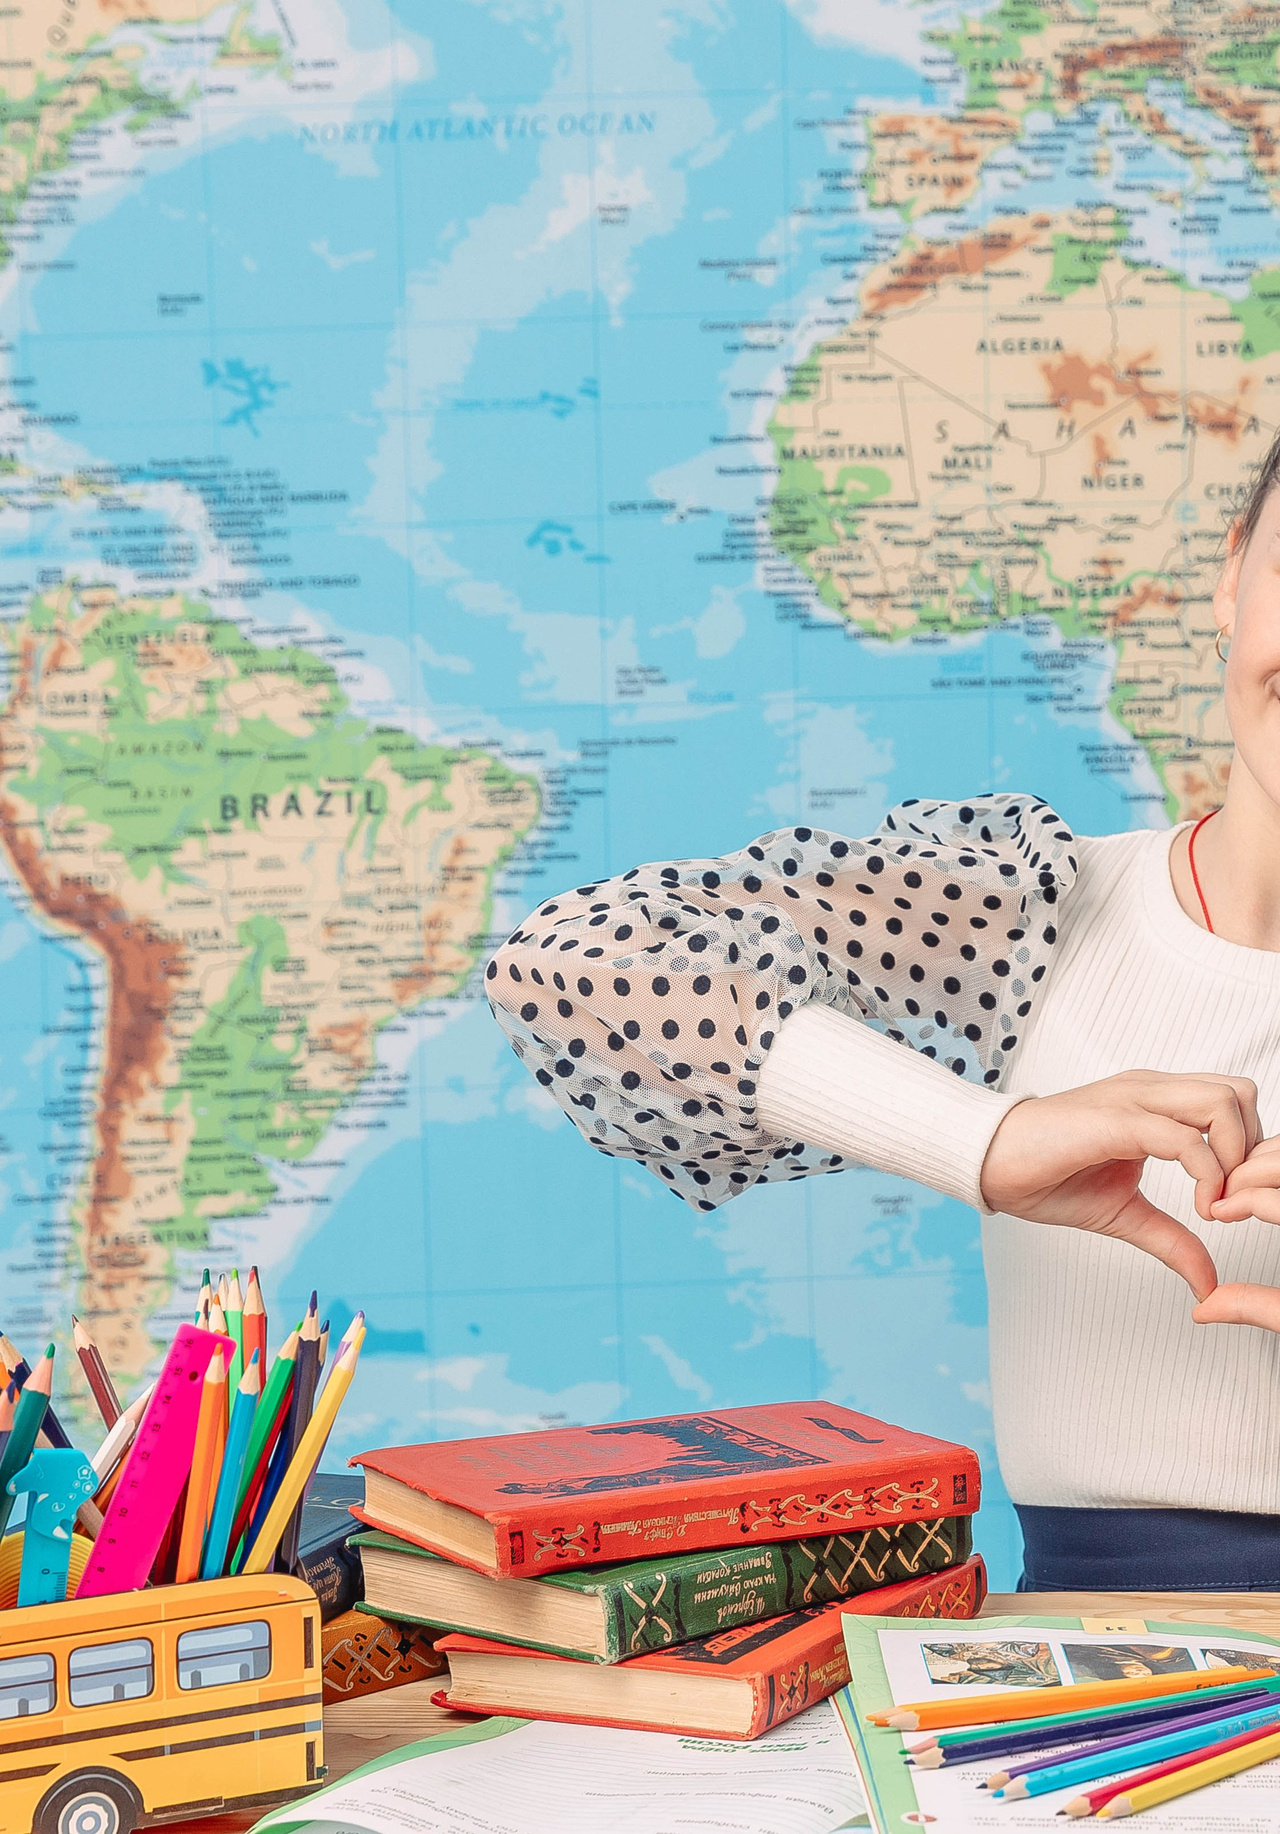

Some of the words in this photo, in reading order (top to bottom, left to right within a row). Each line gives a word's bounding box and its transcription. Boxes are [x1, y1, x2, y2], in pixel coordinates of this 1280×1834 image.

[970, 59, 1044, 74] FRANCE
[301, 120, 396, 145] NORTH
[403, 116, 548, 141] ATLANTIC
[557, 112, 655, 137] OCEAN
[907, 174, 964, 188] SPAIN
[977, 338, 1063, 353] ALGERIA
[1197, 341, 1254, 355] LIBYA
[781, 444, 905, 460] MAURITANIA
[944, 455, 992, 470] MALI
[1082, 475, 1144, 489] NIGER
[1052, 584, 1134, 601] NIGERIA
[102, 630, 213, 646] VENEZUELA
[118, 740, 203, 757] AMAZON
[220, 789, 381, 821] BRAZIL
[96, 1229, 209, 1247] ARGENTINA
[184, 1339, 194, 1349] 16
[174, 1366, 184, 1377] 15
[163, 1395, 172, 1405] 14
[152, 1423, 161, 1433] 13
[141, 1451, 150, 1461] 12
[130, 1480, 138, 1489] 11
[118, 1507, 128, 1518] 10
[717, 1590, 756, 1624] Ефремов
